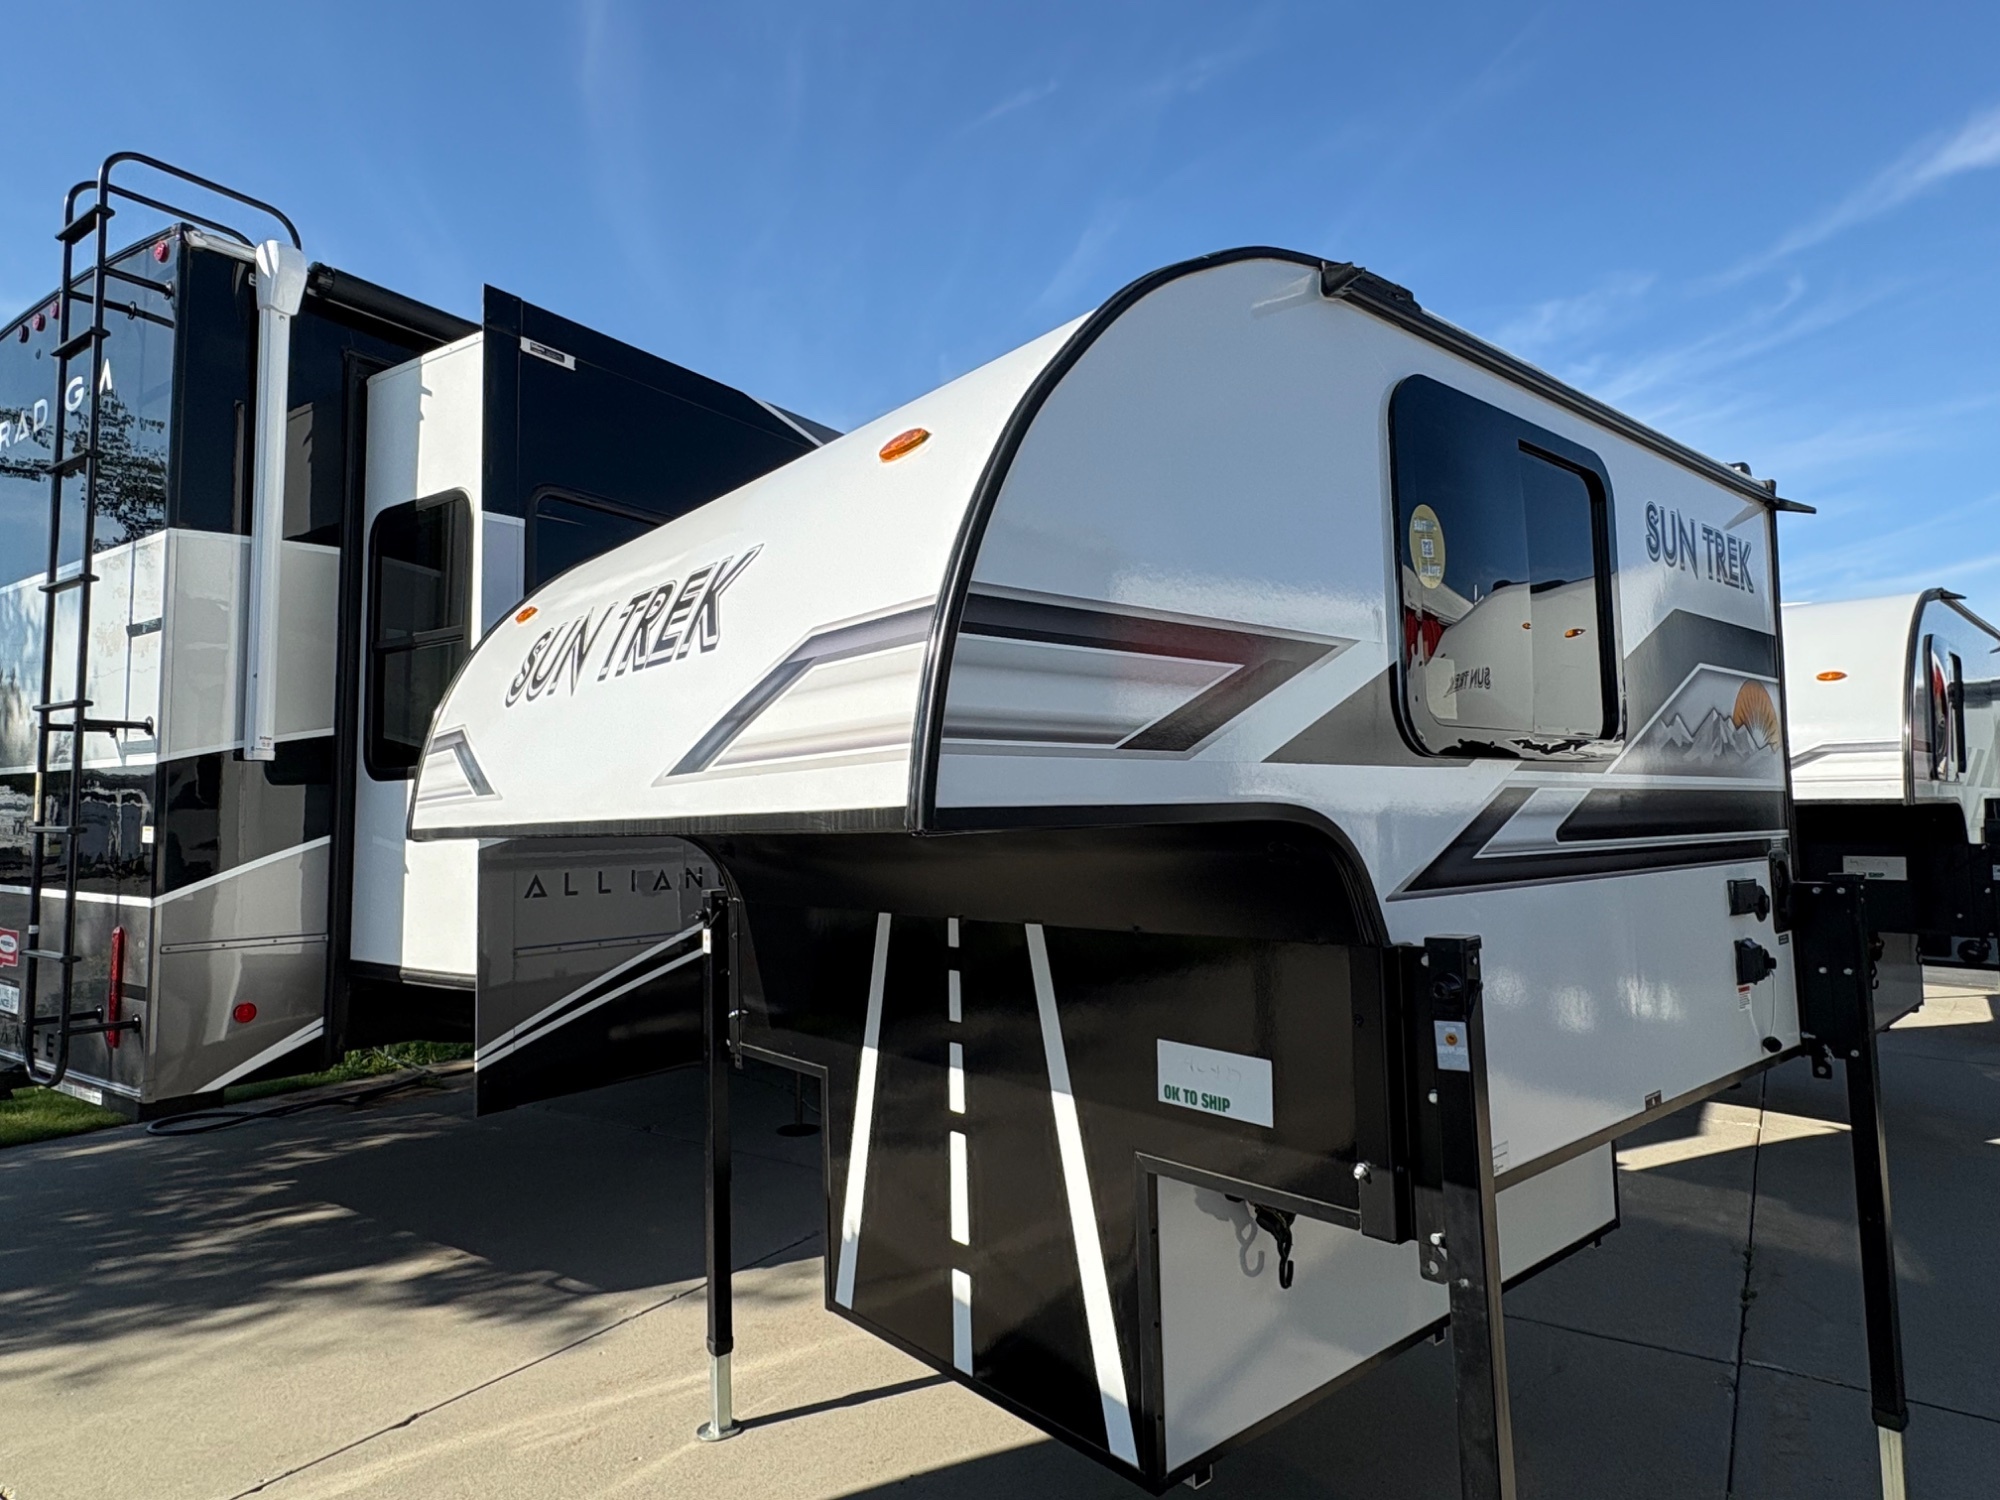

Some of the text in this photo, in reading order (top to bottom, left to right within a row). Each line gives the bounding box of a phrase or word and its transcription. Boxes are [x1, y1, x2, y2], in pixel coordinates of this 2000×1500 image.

[1645, 500, 1754, 594] SUN TREK
[504, 543, 764, 708] SUN TREK
[1164, 1084, 1231, 1113] OK TO SHIP
